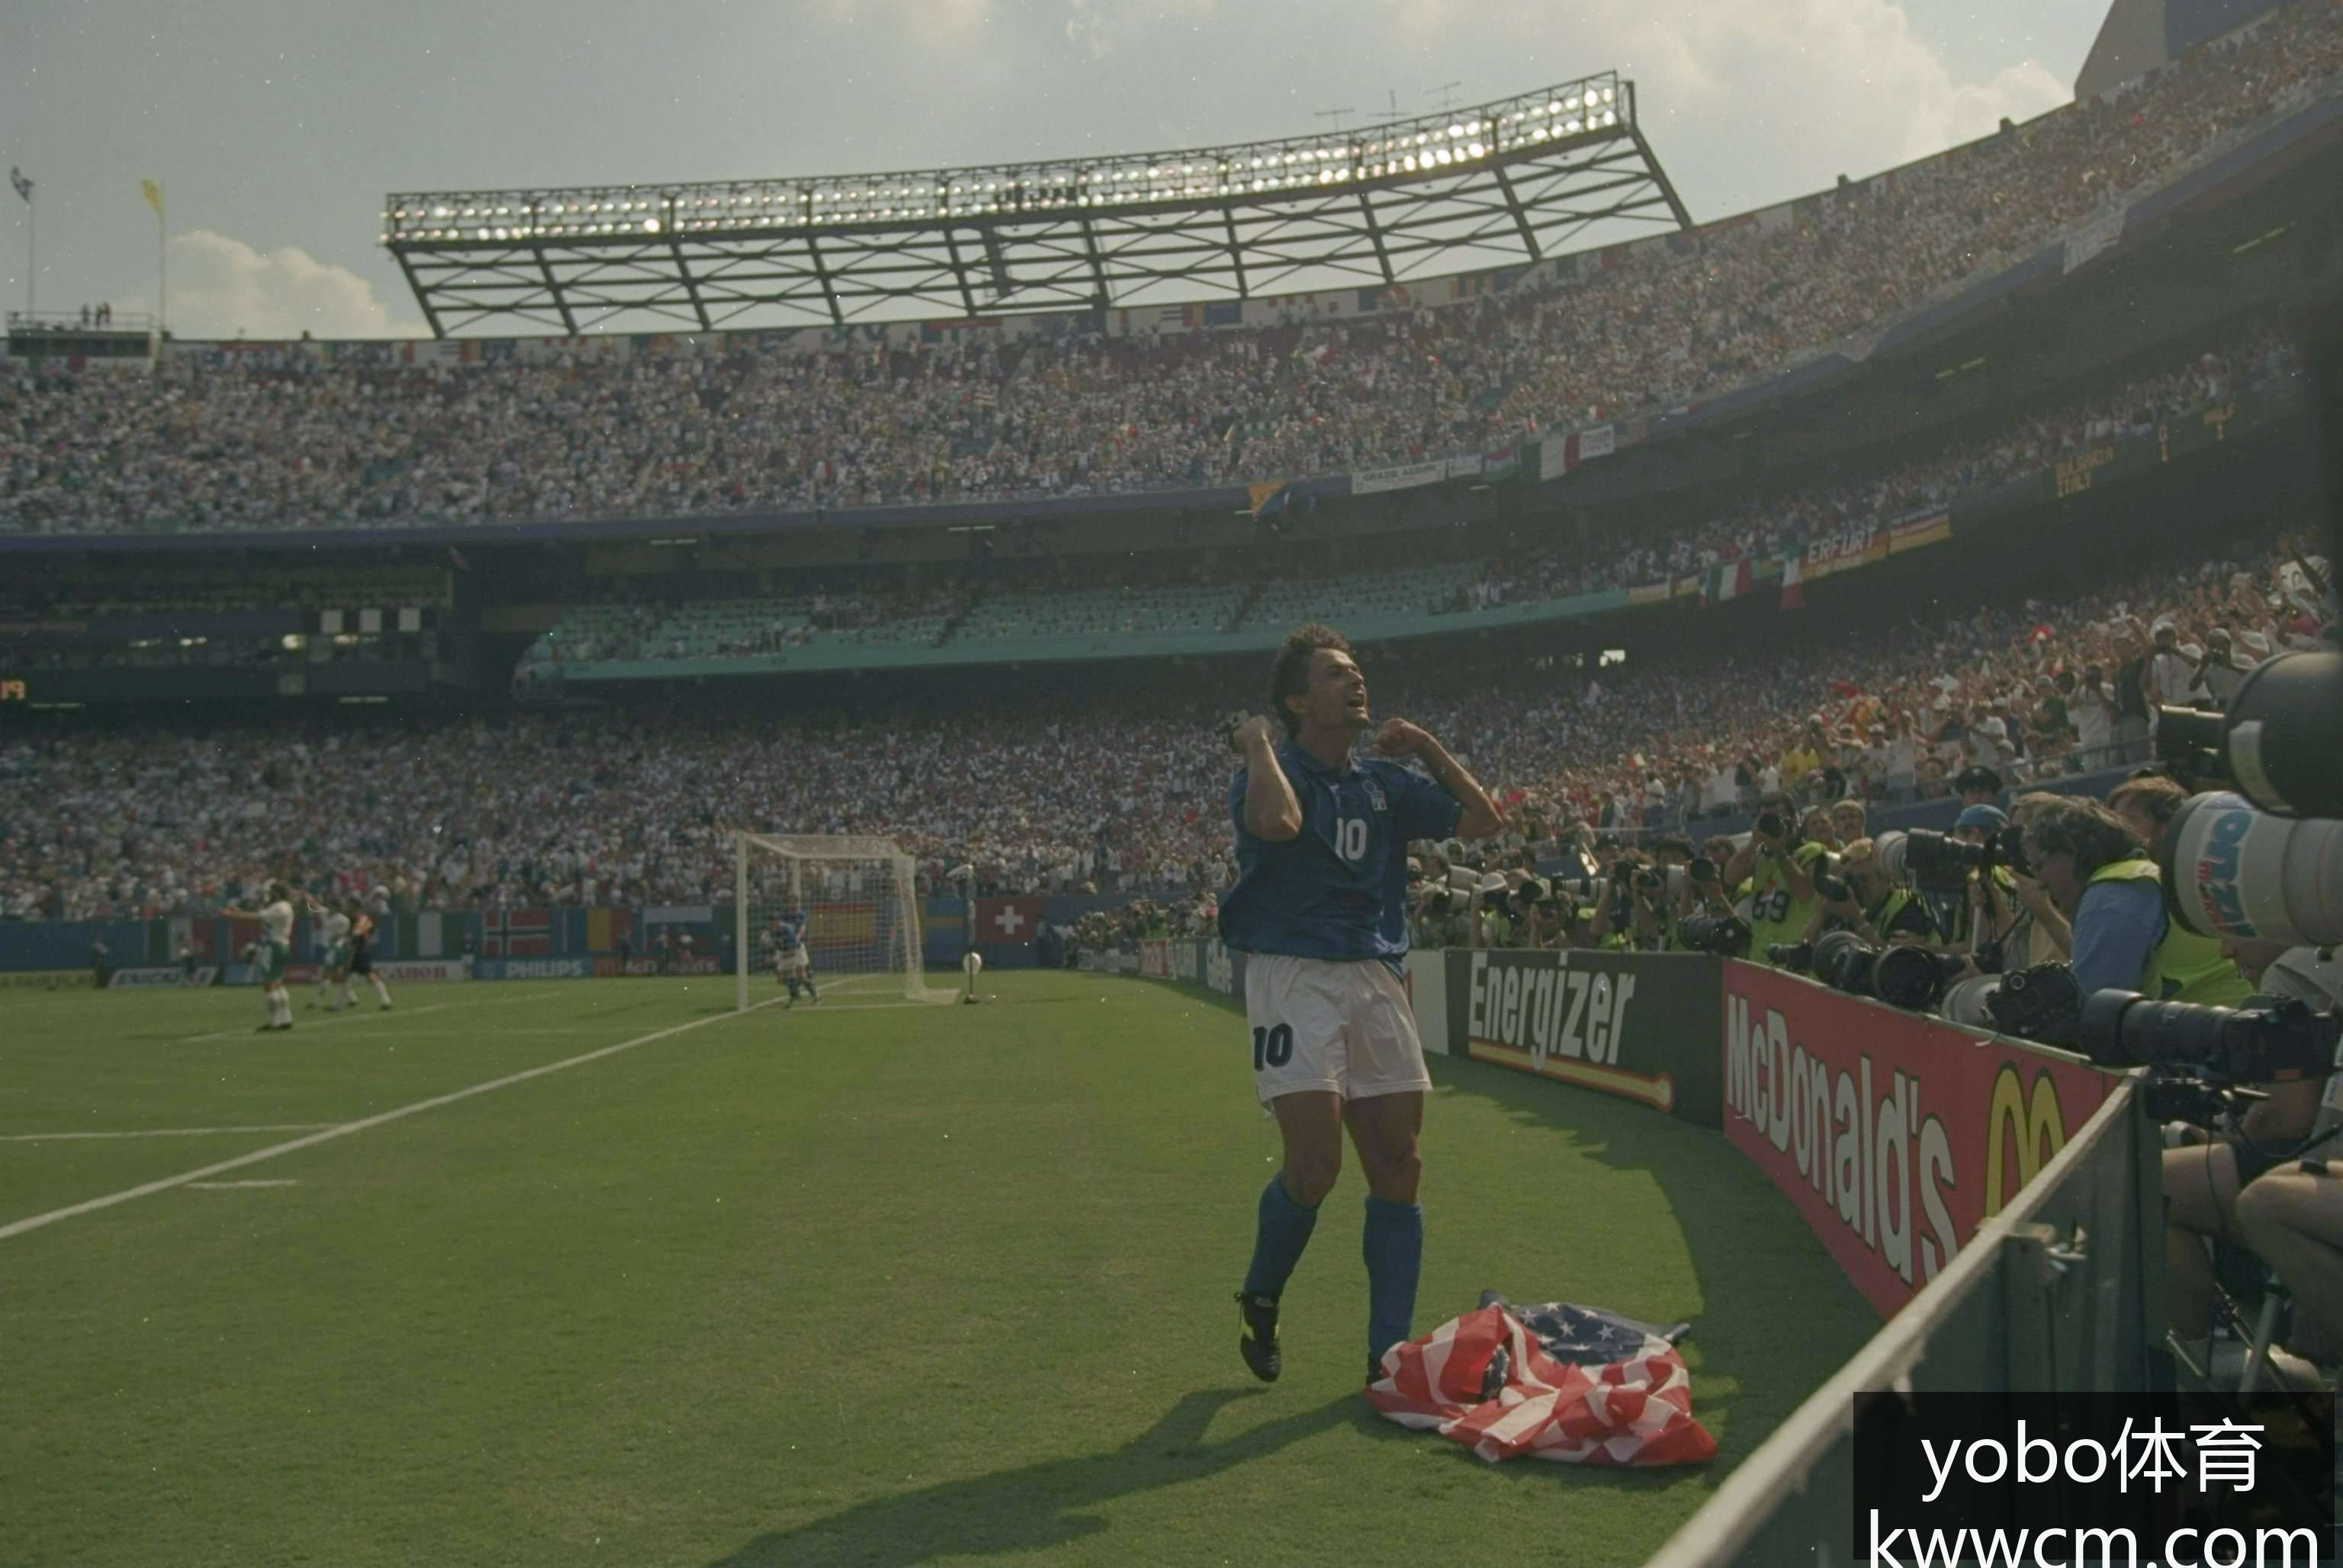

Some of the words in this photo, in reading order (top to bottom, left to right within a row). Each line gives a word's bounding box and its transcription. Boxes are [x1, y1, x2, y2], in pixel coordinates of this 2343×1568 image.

[1808, 524, 1877, 564] ERFURT
[1335, 818, 1368, 860] 10
[506, 960, 583, 978] PHILIPS
[1468, 951, 1636, 1071] Energizer
[1253, 1023, 1294, 1072] 10
[1727, 993, 1959, 1287] McDonald's
